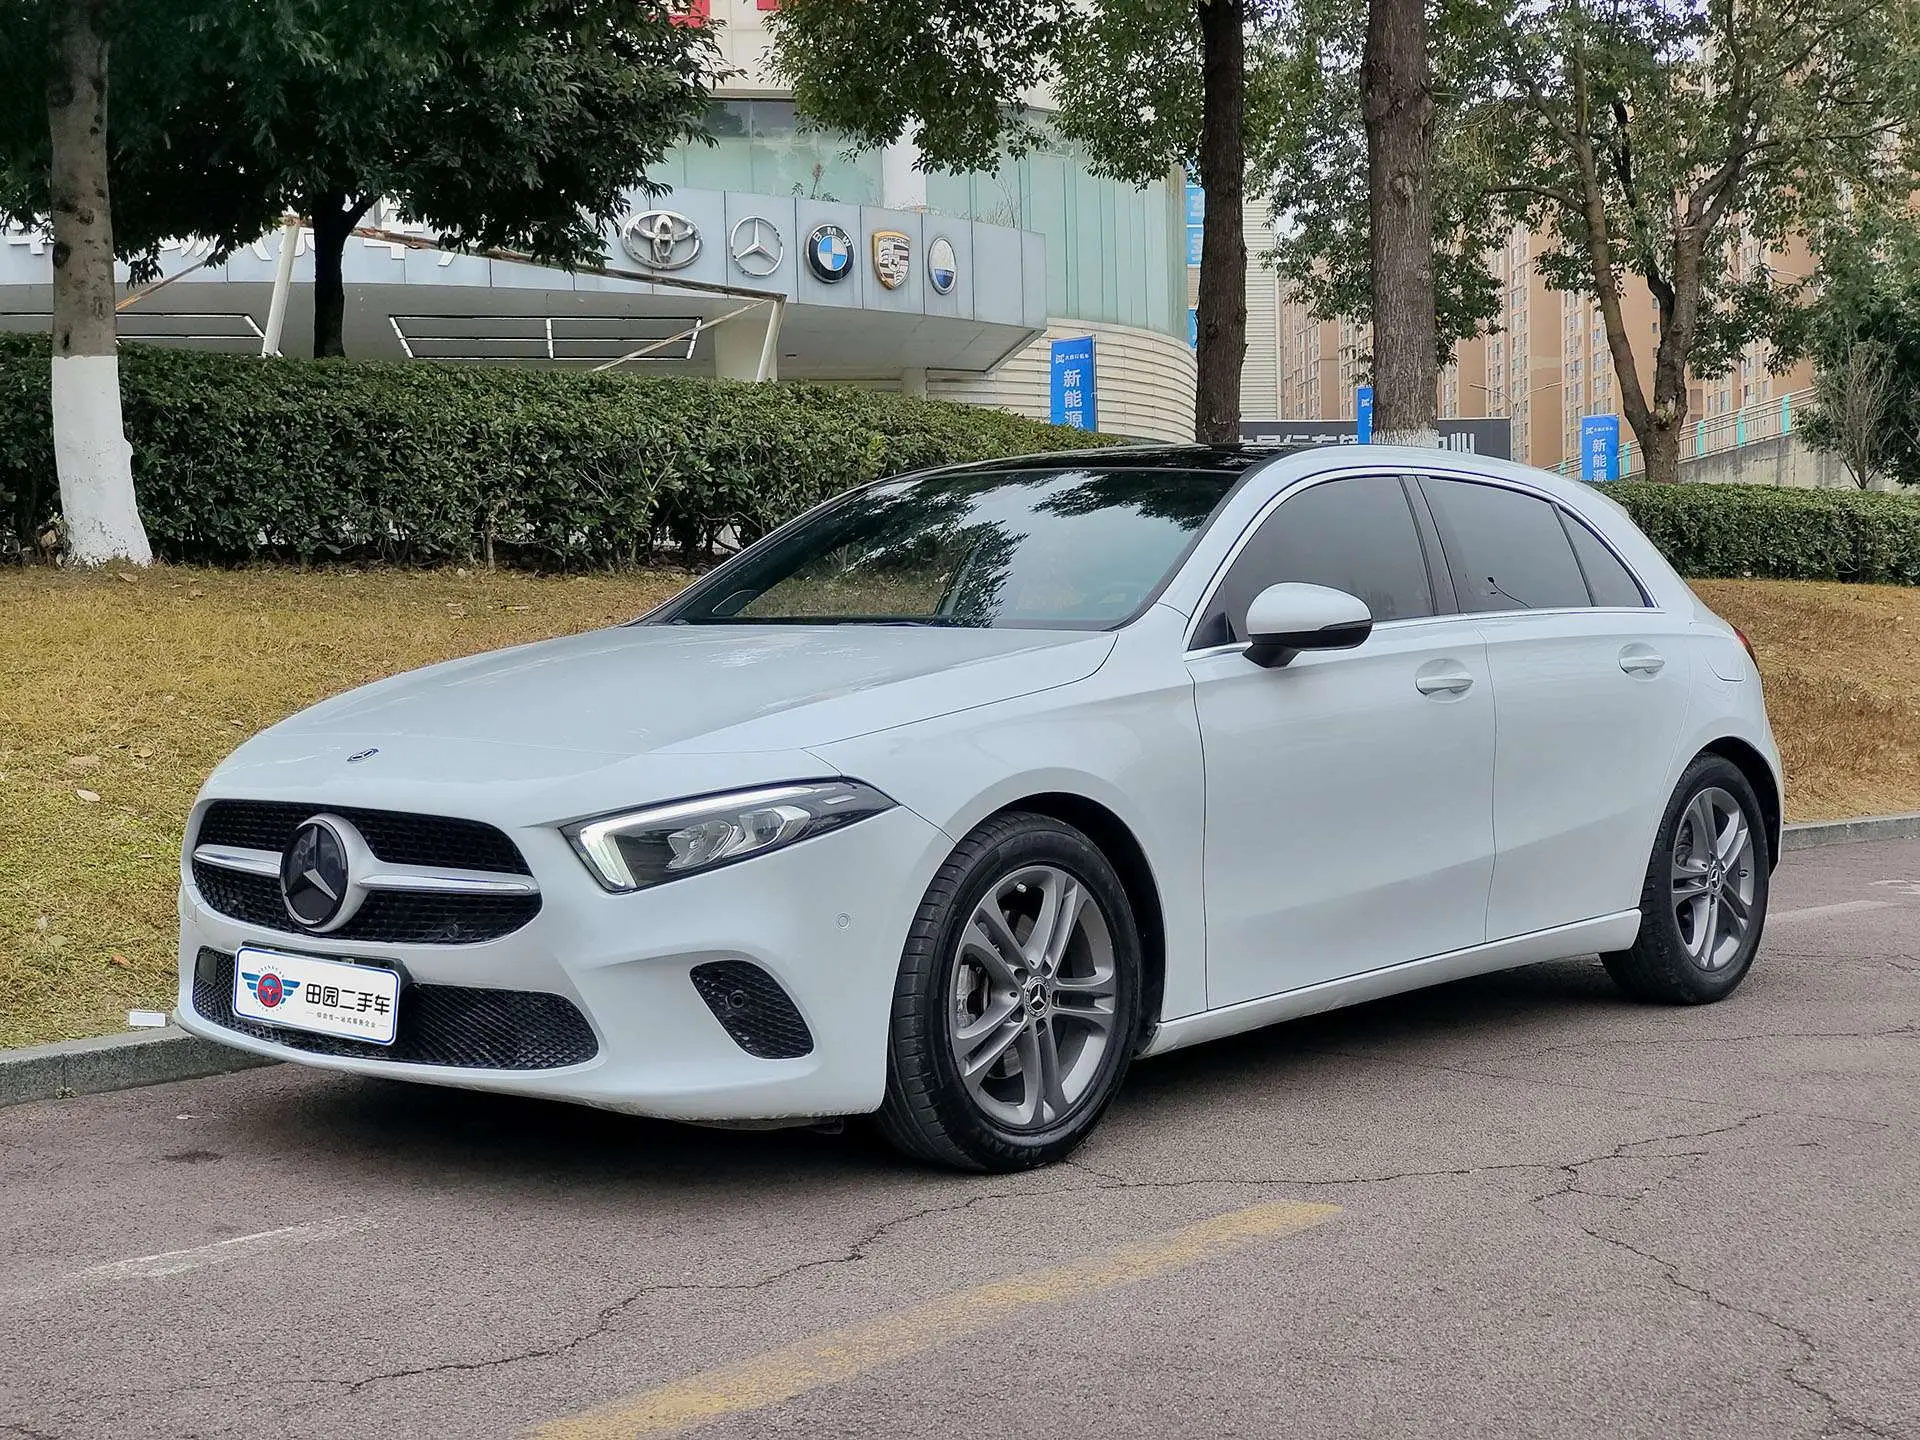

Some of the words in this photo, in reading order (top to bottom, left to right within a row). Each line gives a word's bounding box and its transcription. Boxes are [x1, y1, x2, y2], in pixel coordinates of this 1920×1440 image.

[812, 226, 851, 248] BMW
[1063, 369, 1084, 428] 新能源
[1592, 439, 1608, 482] 新能源
[305, 983, 391, 1016] 田园二手车
